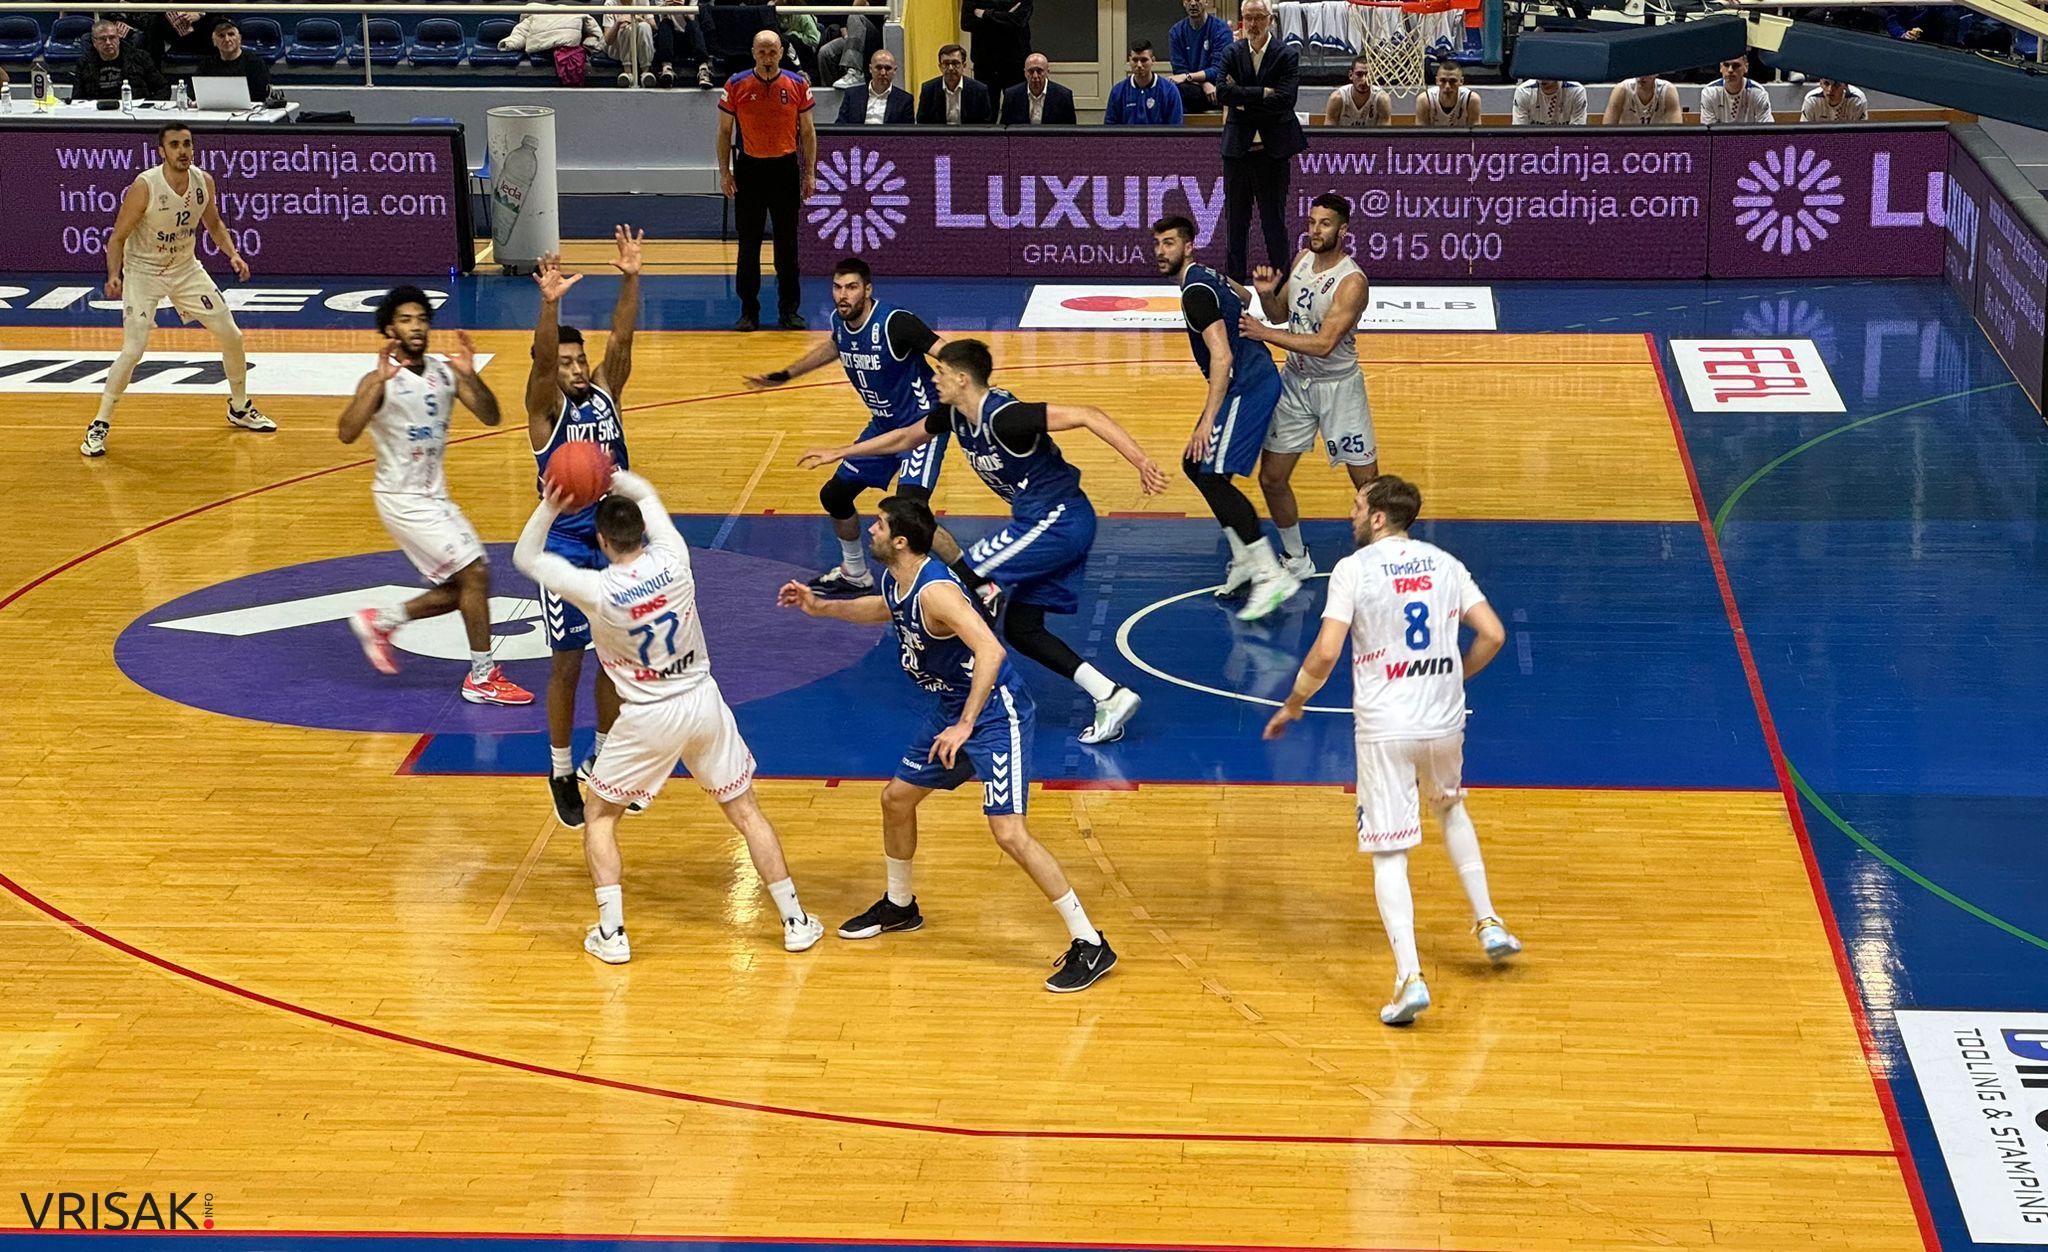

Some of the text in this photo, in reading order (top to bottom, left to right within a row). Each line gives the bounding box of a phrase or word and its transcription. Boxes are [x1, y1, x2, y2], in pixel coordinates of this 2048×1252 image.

[56, 142, 438, 179] www.lurygradnja.com
[1298, 145, 1693, 182] www.luxurygradnja.com
[175, 211, 190, 226] 12
[934, 154, 1224, 249] Luxury
[1022, 244, 1146, 265] GRADNJA
[1369, 232, 1430, 260] 915
[1441, 233, 1503, 261] 000
[1376, 301, 1478, 310] NLB
[1341, 434, 1363, 454] 25
[628, 611, 679, 667] 77
[1403, 601, 1431, 650] 8
[1953, 1028, 2007, 1101] TOOLING
[1982, 1108, 2013, 1120] &
[1990, 1126, 2048, 1224] STAMPING
